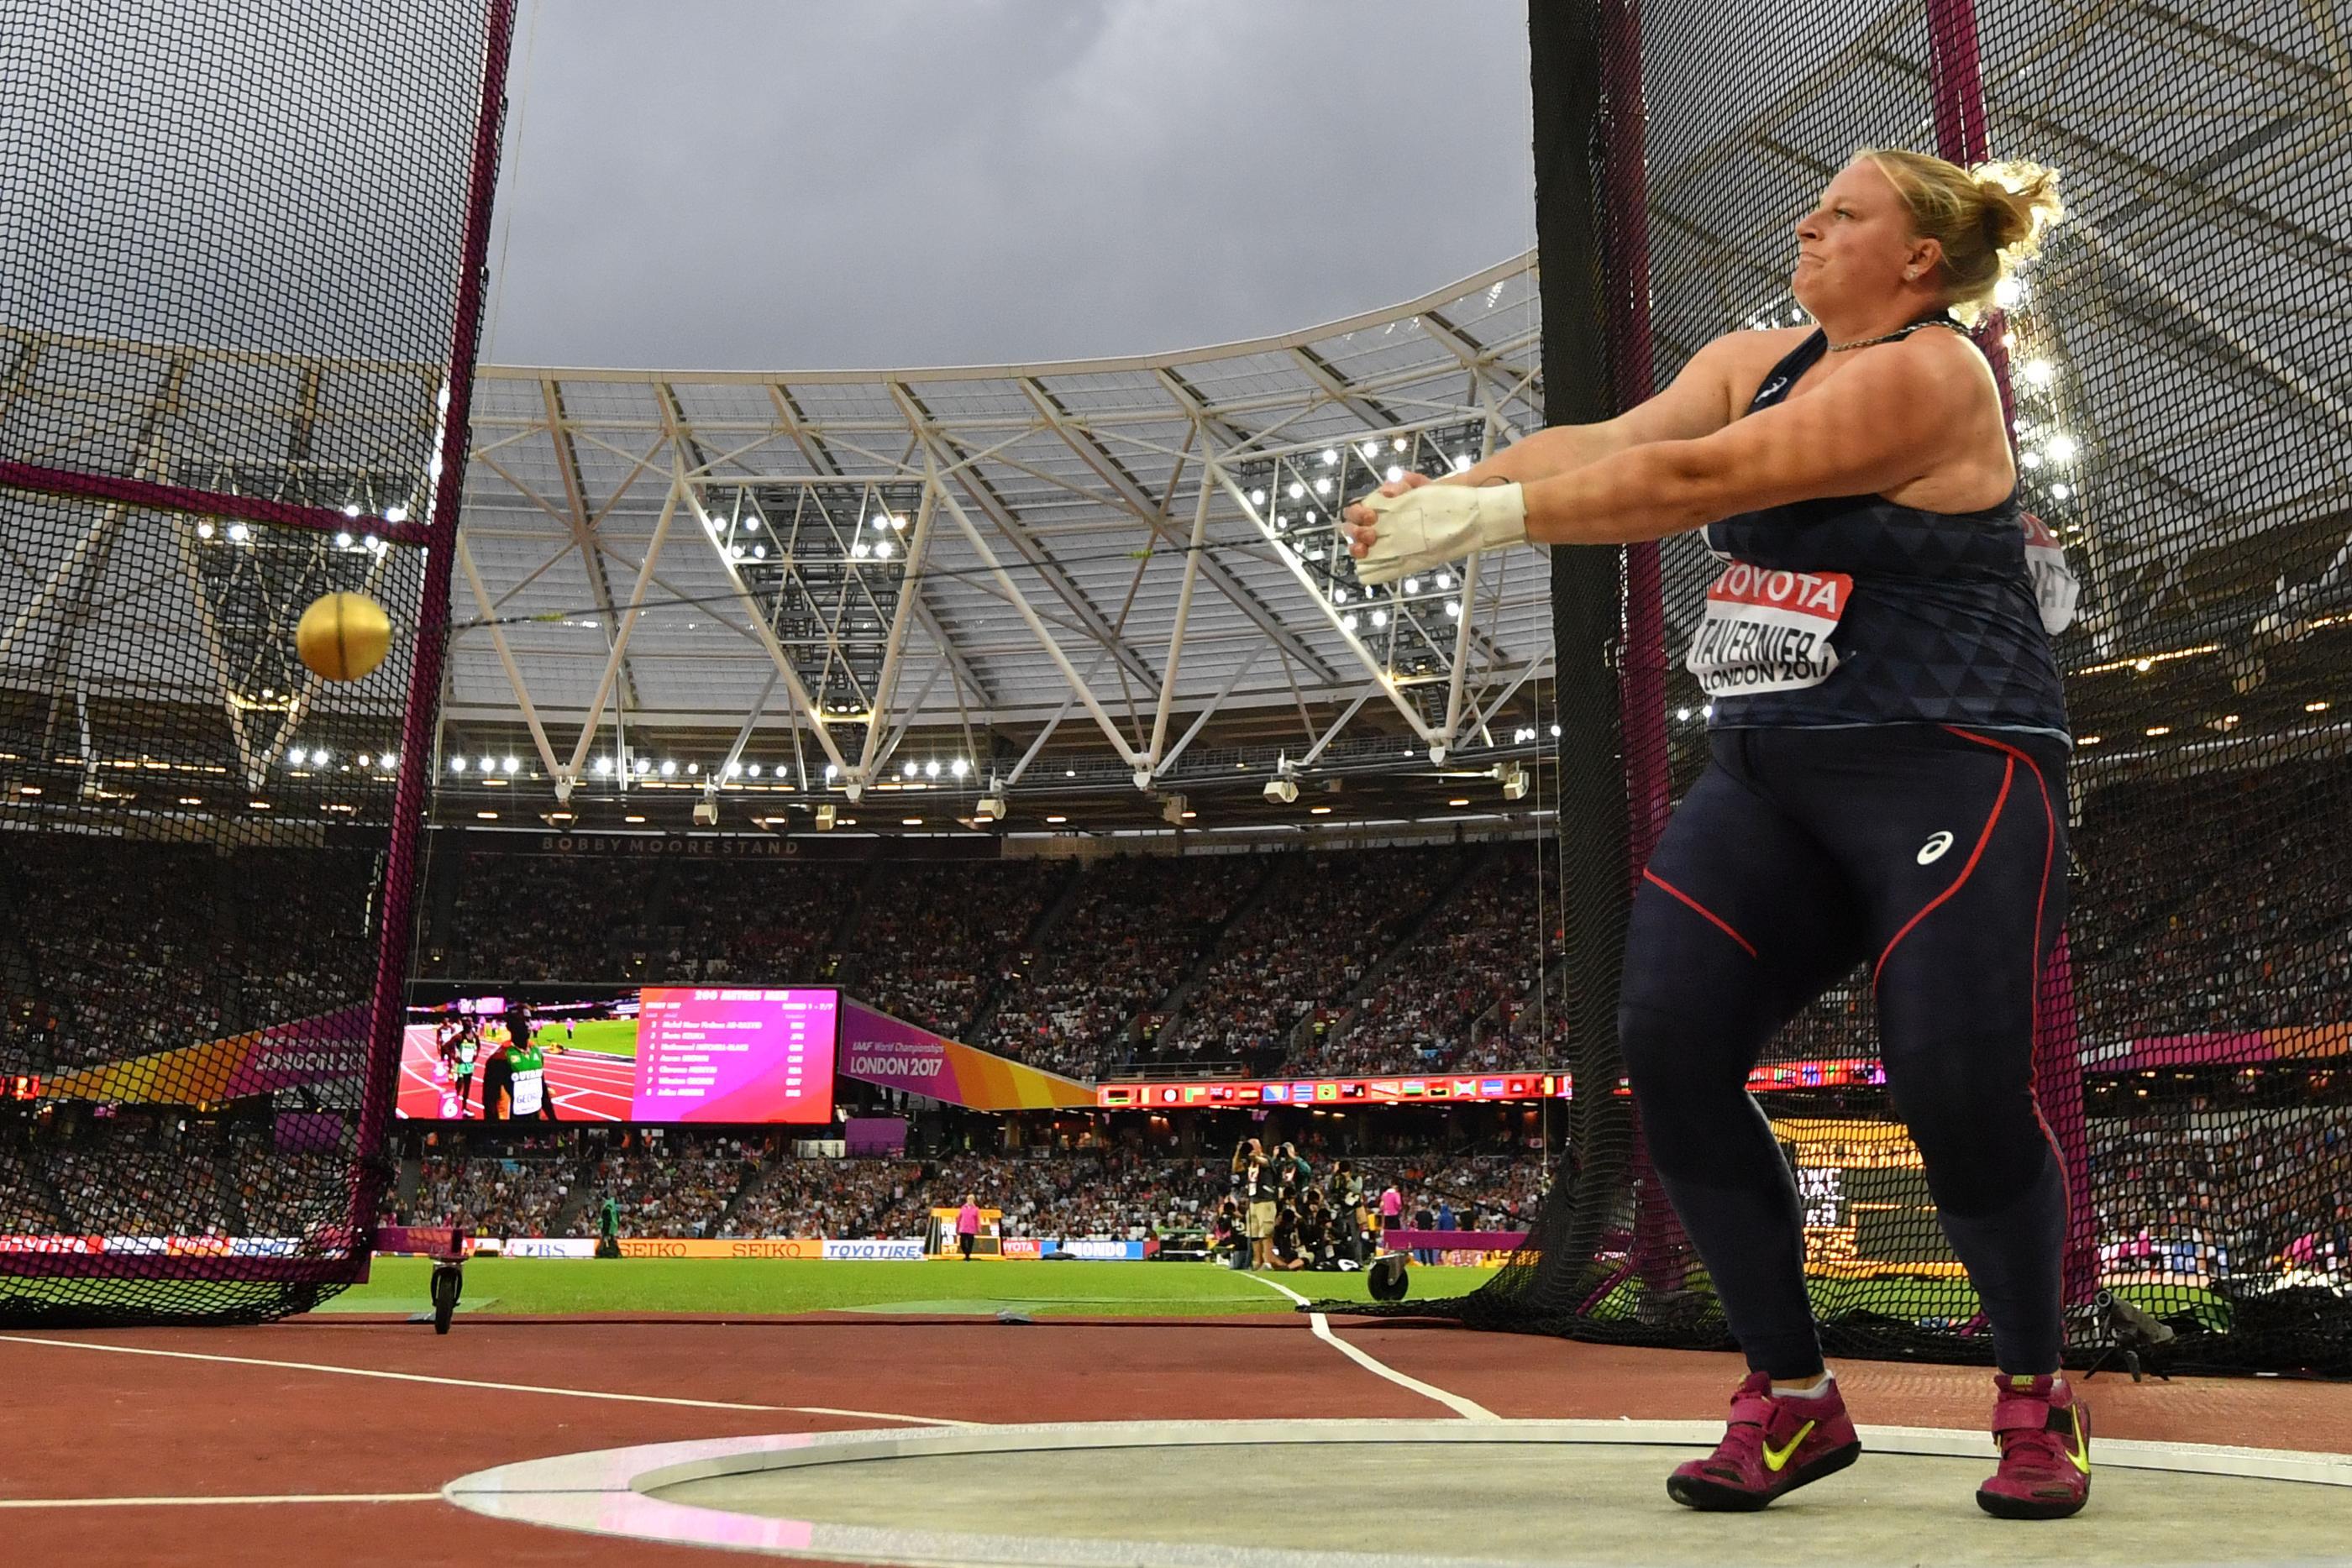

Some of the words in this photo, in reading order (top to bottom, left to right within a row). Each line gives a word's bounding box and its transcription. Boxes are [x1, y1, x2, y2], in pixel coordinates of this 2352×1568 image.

[1716, 564, 1837, 613] TOYOTA
[1694, 618, 1817, 664] TAVERNIER
[1704, 663, 1776, 690] LONDON
[543, 837, 622, 852] BOBBY
[629, 839, 714, 853] MOORE
[722, 841, 798, 854] STAND
[852, 1041, 874, 1051] IAAF
[874, 1042, 895, 1051] World
[895, 1042, 944, 1053] Championships
[850, 1057, 908, 1075] LONDON
[910, 1058, 943, 1077] 2017
[443, 1097, 458, 1118] 6
[619, 1243, 686, 1257] SEIKO
[732, 1243, 801, 1257] SEIKO
[829, 1245, 874, 1256] TOYO
[1004, 1242, 1034, 1251] YOTA
[1068, 1241, 1127, 1257] MONDO
